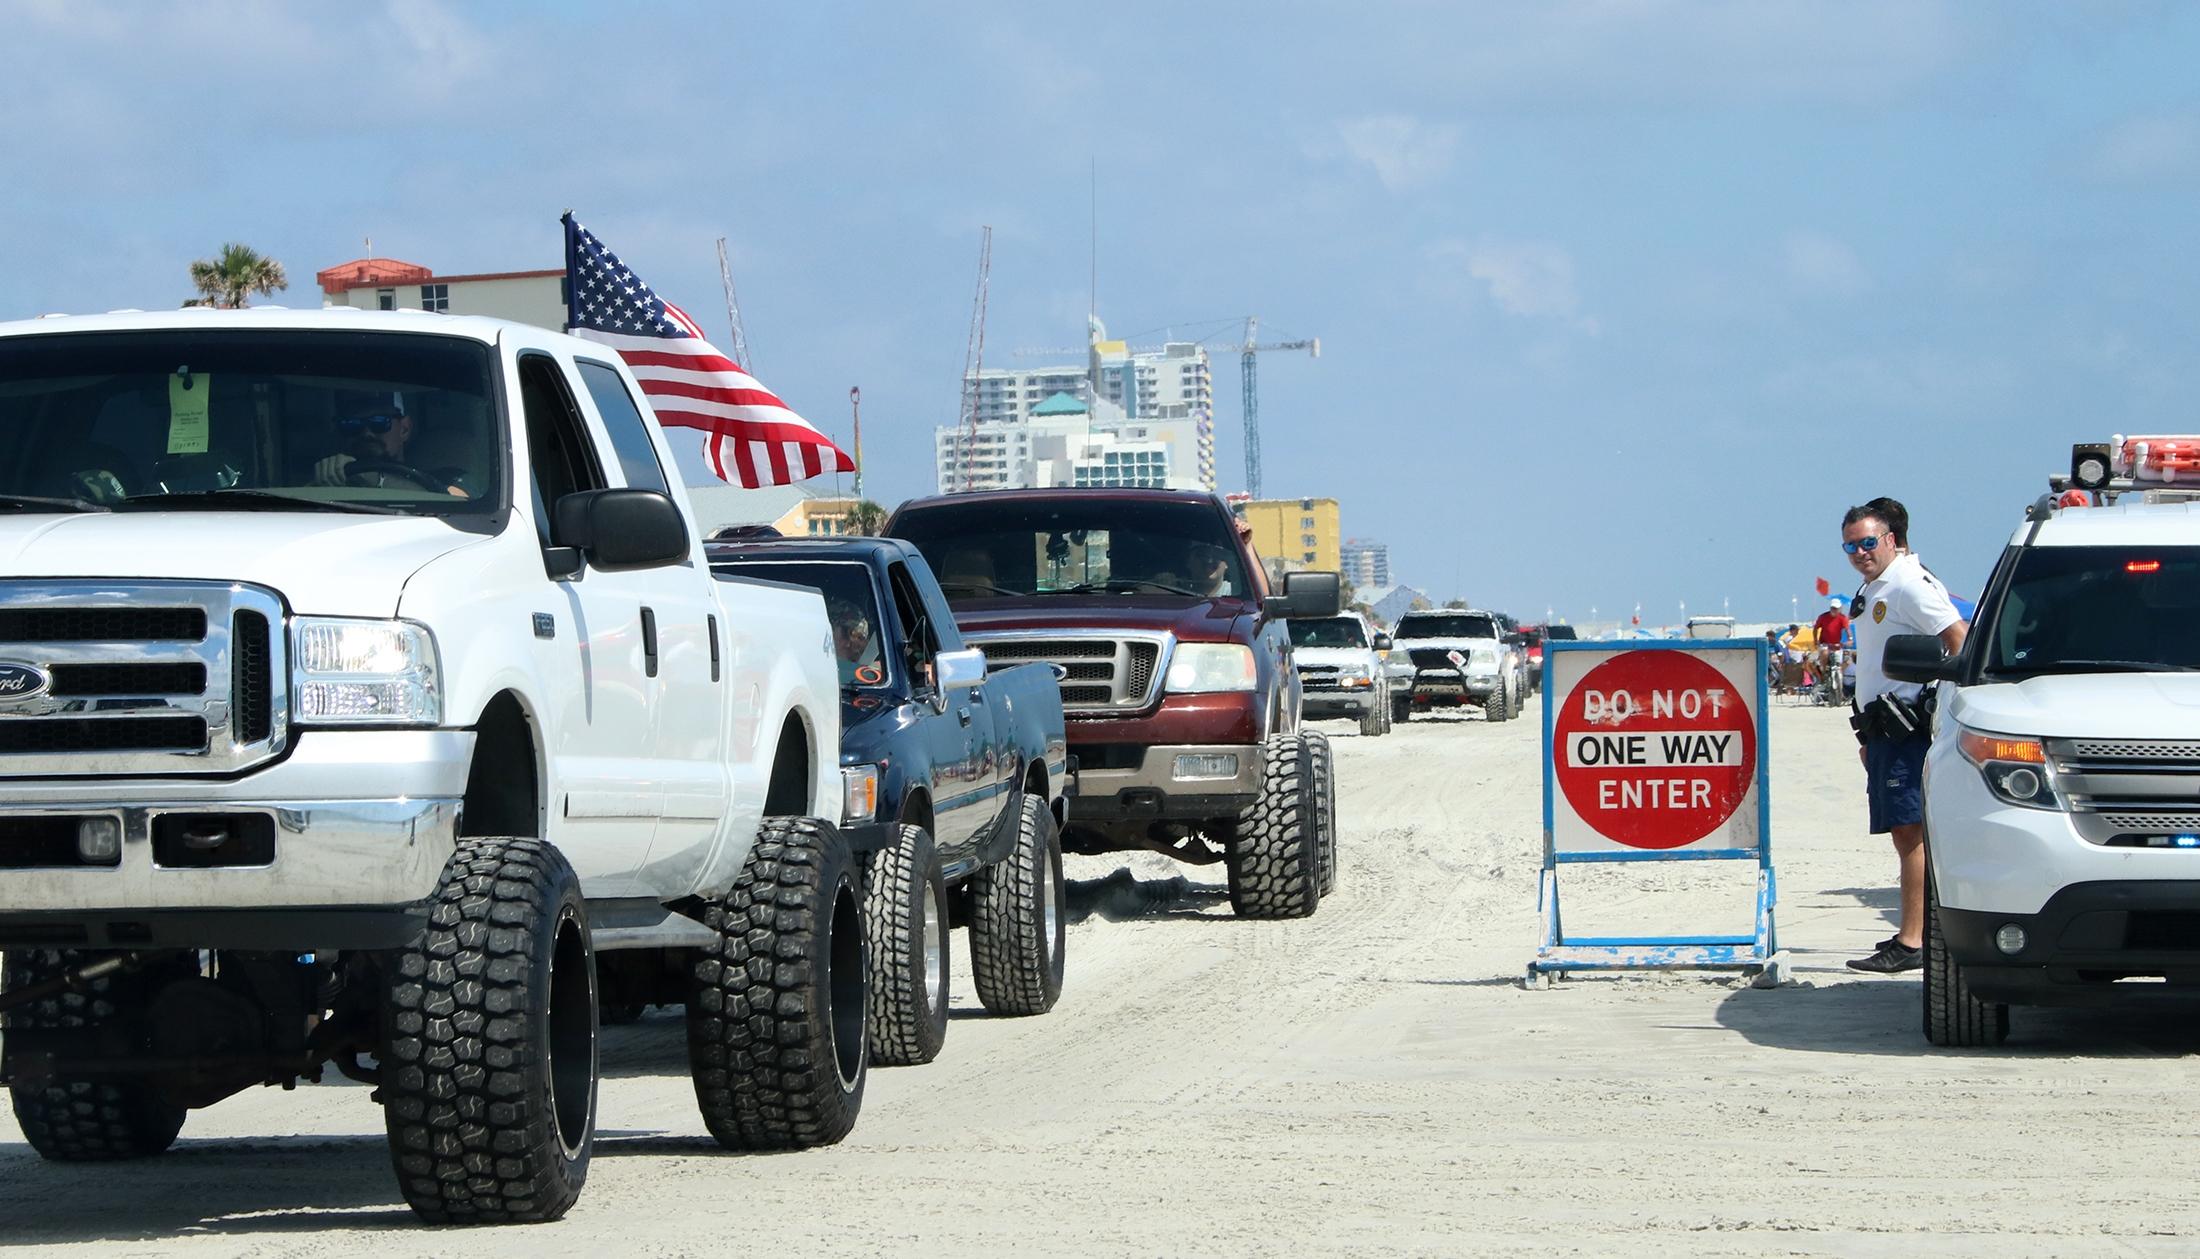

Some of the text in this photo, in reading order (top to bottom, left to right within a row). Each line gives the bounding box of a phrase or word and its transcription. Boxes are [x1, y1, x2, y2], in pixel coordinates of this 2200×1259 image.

[1584, 689, 1725, 720] DO NOT
[1577, 735, 1731, 765] ONE WAY
[1599, 779, 1711, 809] ENTER
